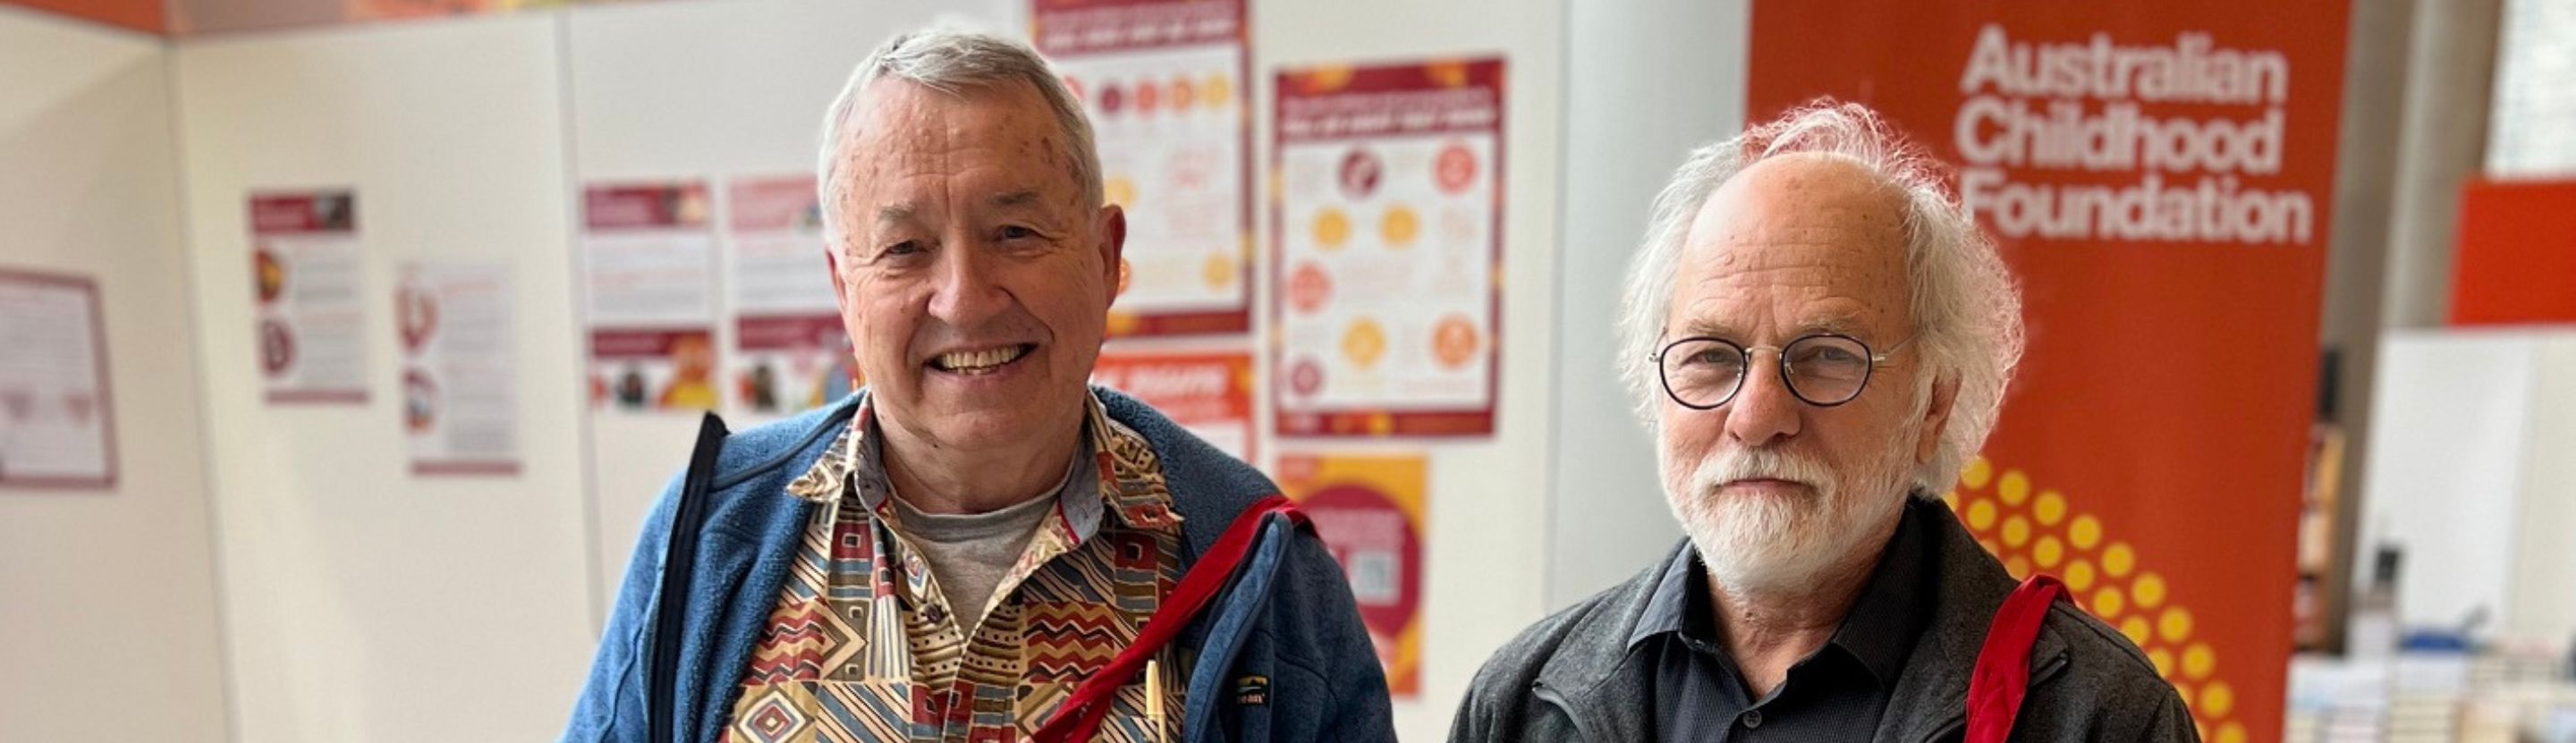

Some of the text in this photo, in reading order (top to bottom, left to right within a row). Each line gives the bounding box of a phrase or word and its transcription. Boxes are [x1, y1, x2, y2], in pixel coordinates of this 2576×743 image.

[1962, 25, 2287, 104] Australian
[1954, 95, 2284, 173] Childhood
[1961, 167, 2313, 244] Foundation
